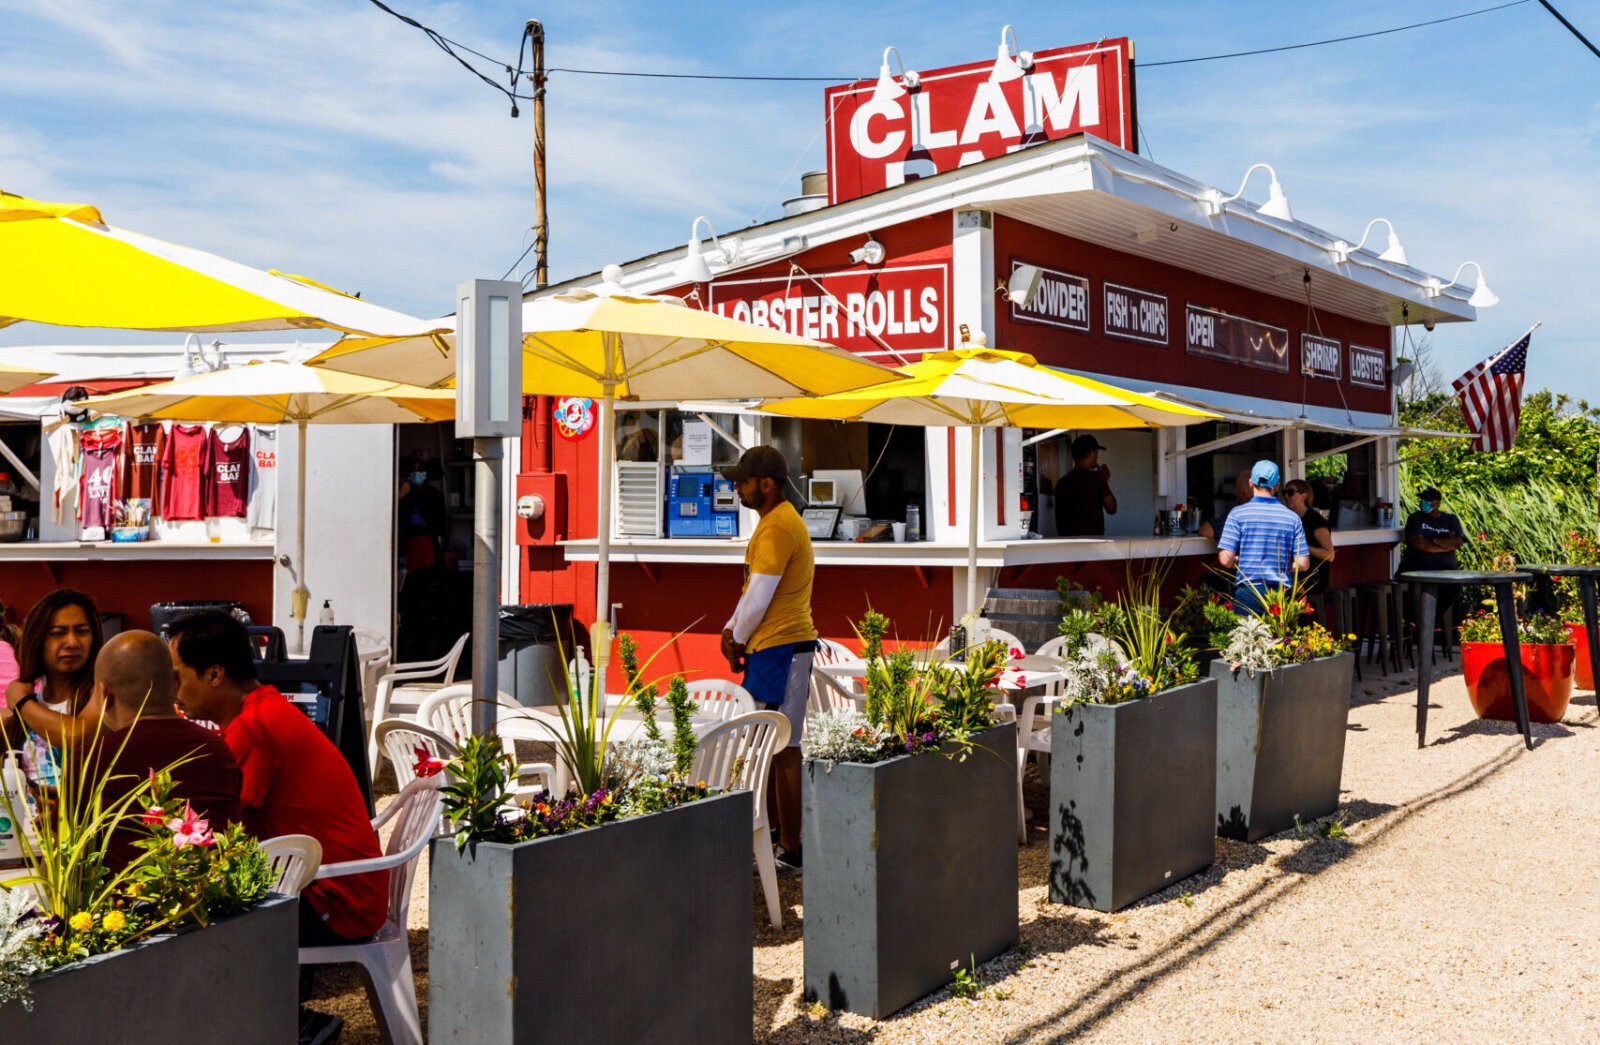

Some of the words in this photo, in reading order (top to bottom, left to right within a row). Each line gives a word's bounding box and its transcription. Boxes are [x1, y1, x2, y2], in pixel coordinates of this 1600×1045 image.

[850, 64, 1099, 159] CLAM
[847, 286, 939, 338] ROLLS
[1020, 277, 1086, 322] OWDER
[1107, 291, 1128, 329] FISH
[1140, 299, 1165, 337] CHIPS
[1188, 312, 1215, 348] OPEN
[1305, 341, 1339, 373] SHRIMP
[1351, 352, 1384, 381] LOBSTER
[256, 450, 276, 459] CLA
